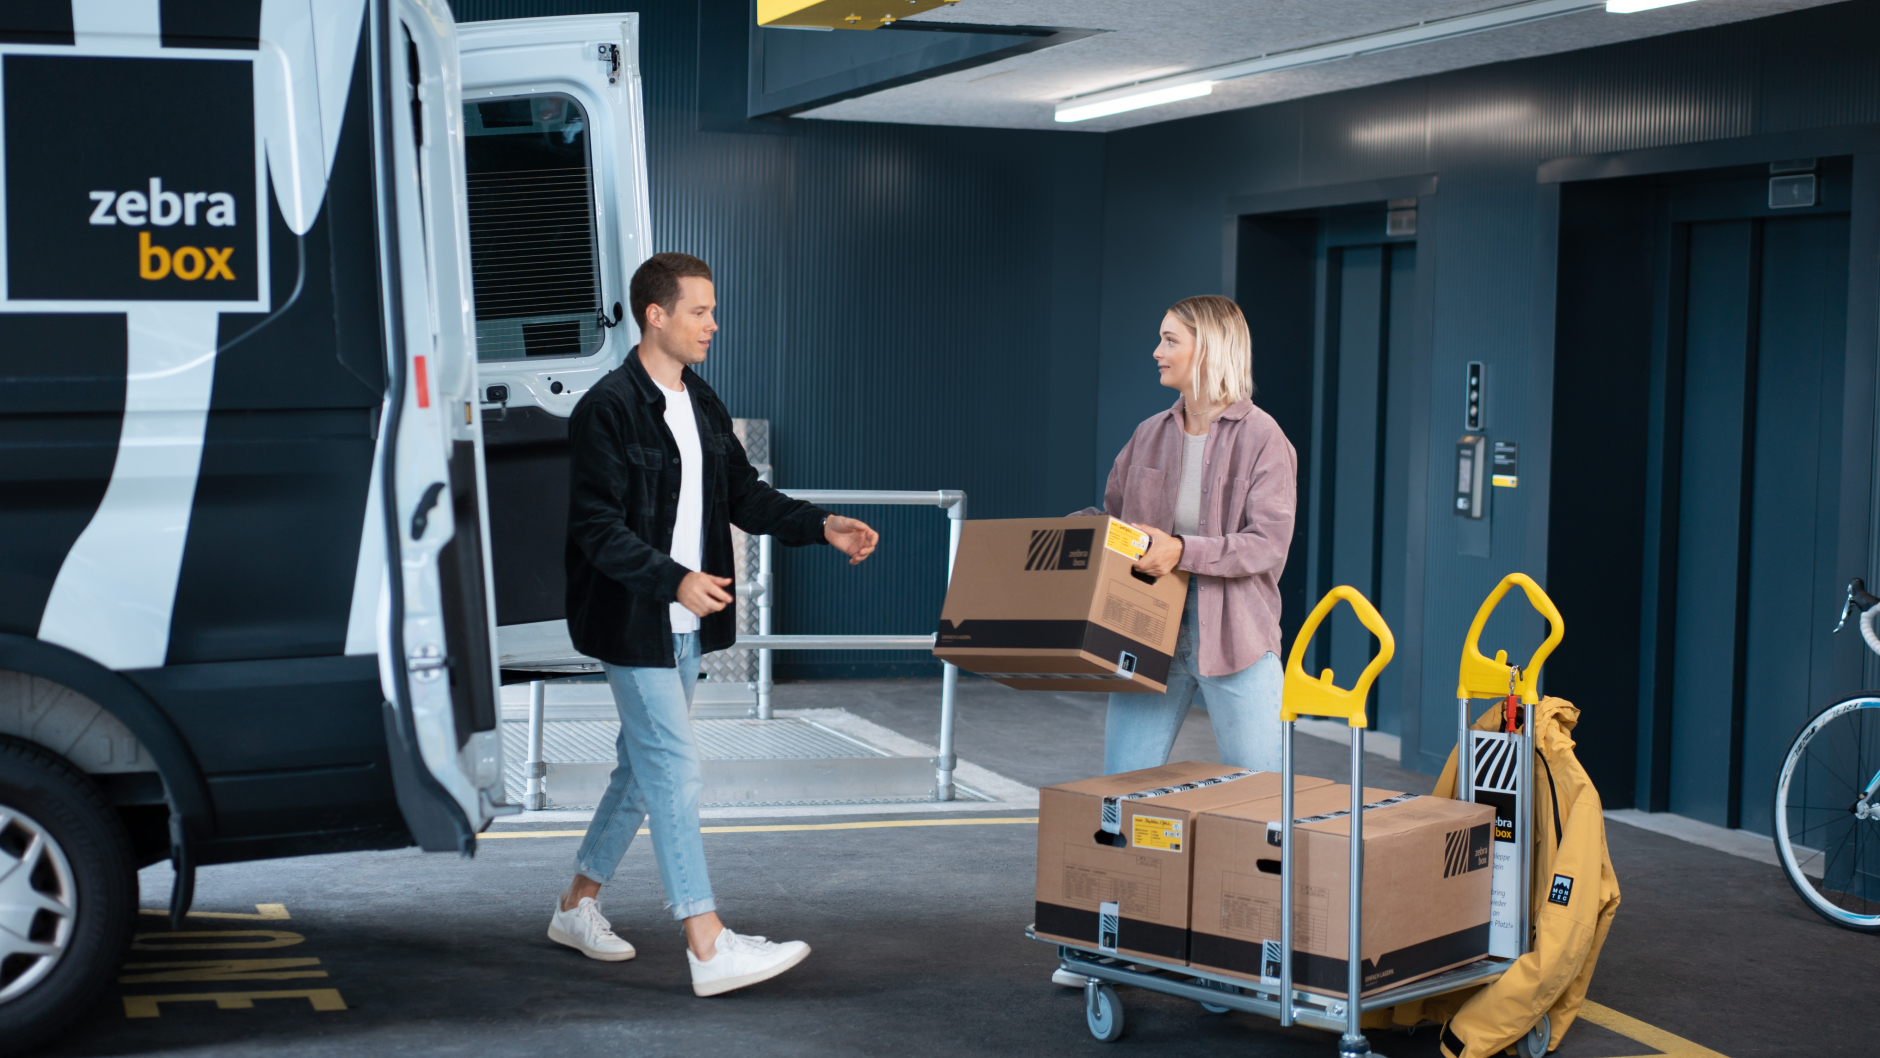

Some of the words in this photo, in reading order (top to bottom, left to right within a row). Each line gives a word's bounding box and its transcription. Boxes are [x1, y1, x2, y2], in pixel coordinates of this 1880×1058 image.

[88, 176, 236, 227] zebra
[138, 231, 237, 281] box
[1495, 827, 1512, 839] box
[1475, 846, 1488, 857] zebra
[1478, 856, 1487, 866] box
[1551, 893, 1568, 901] TEC
[1552, 887, 1569, 896] MON
